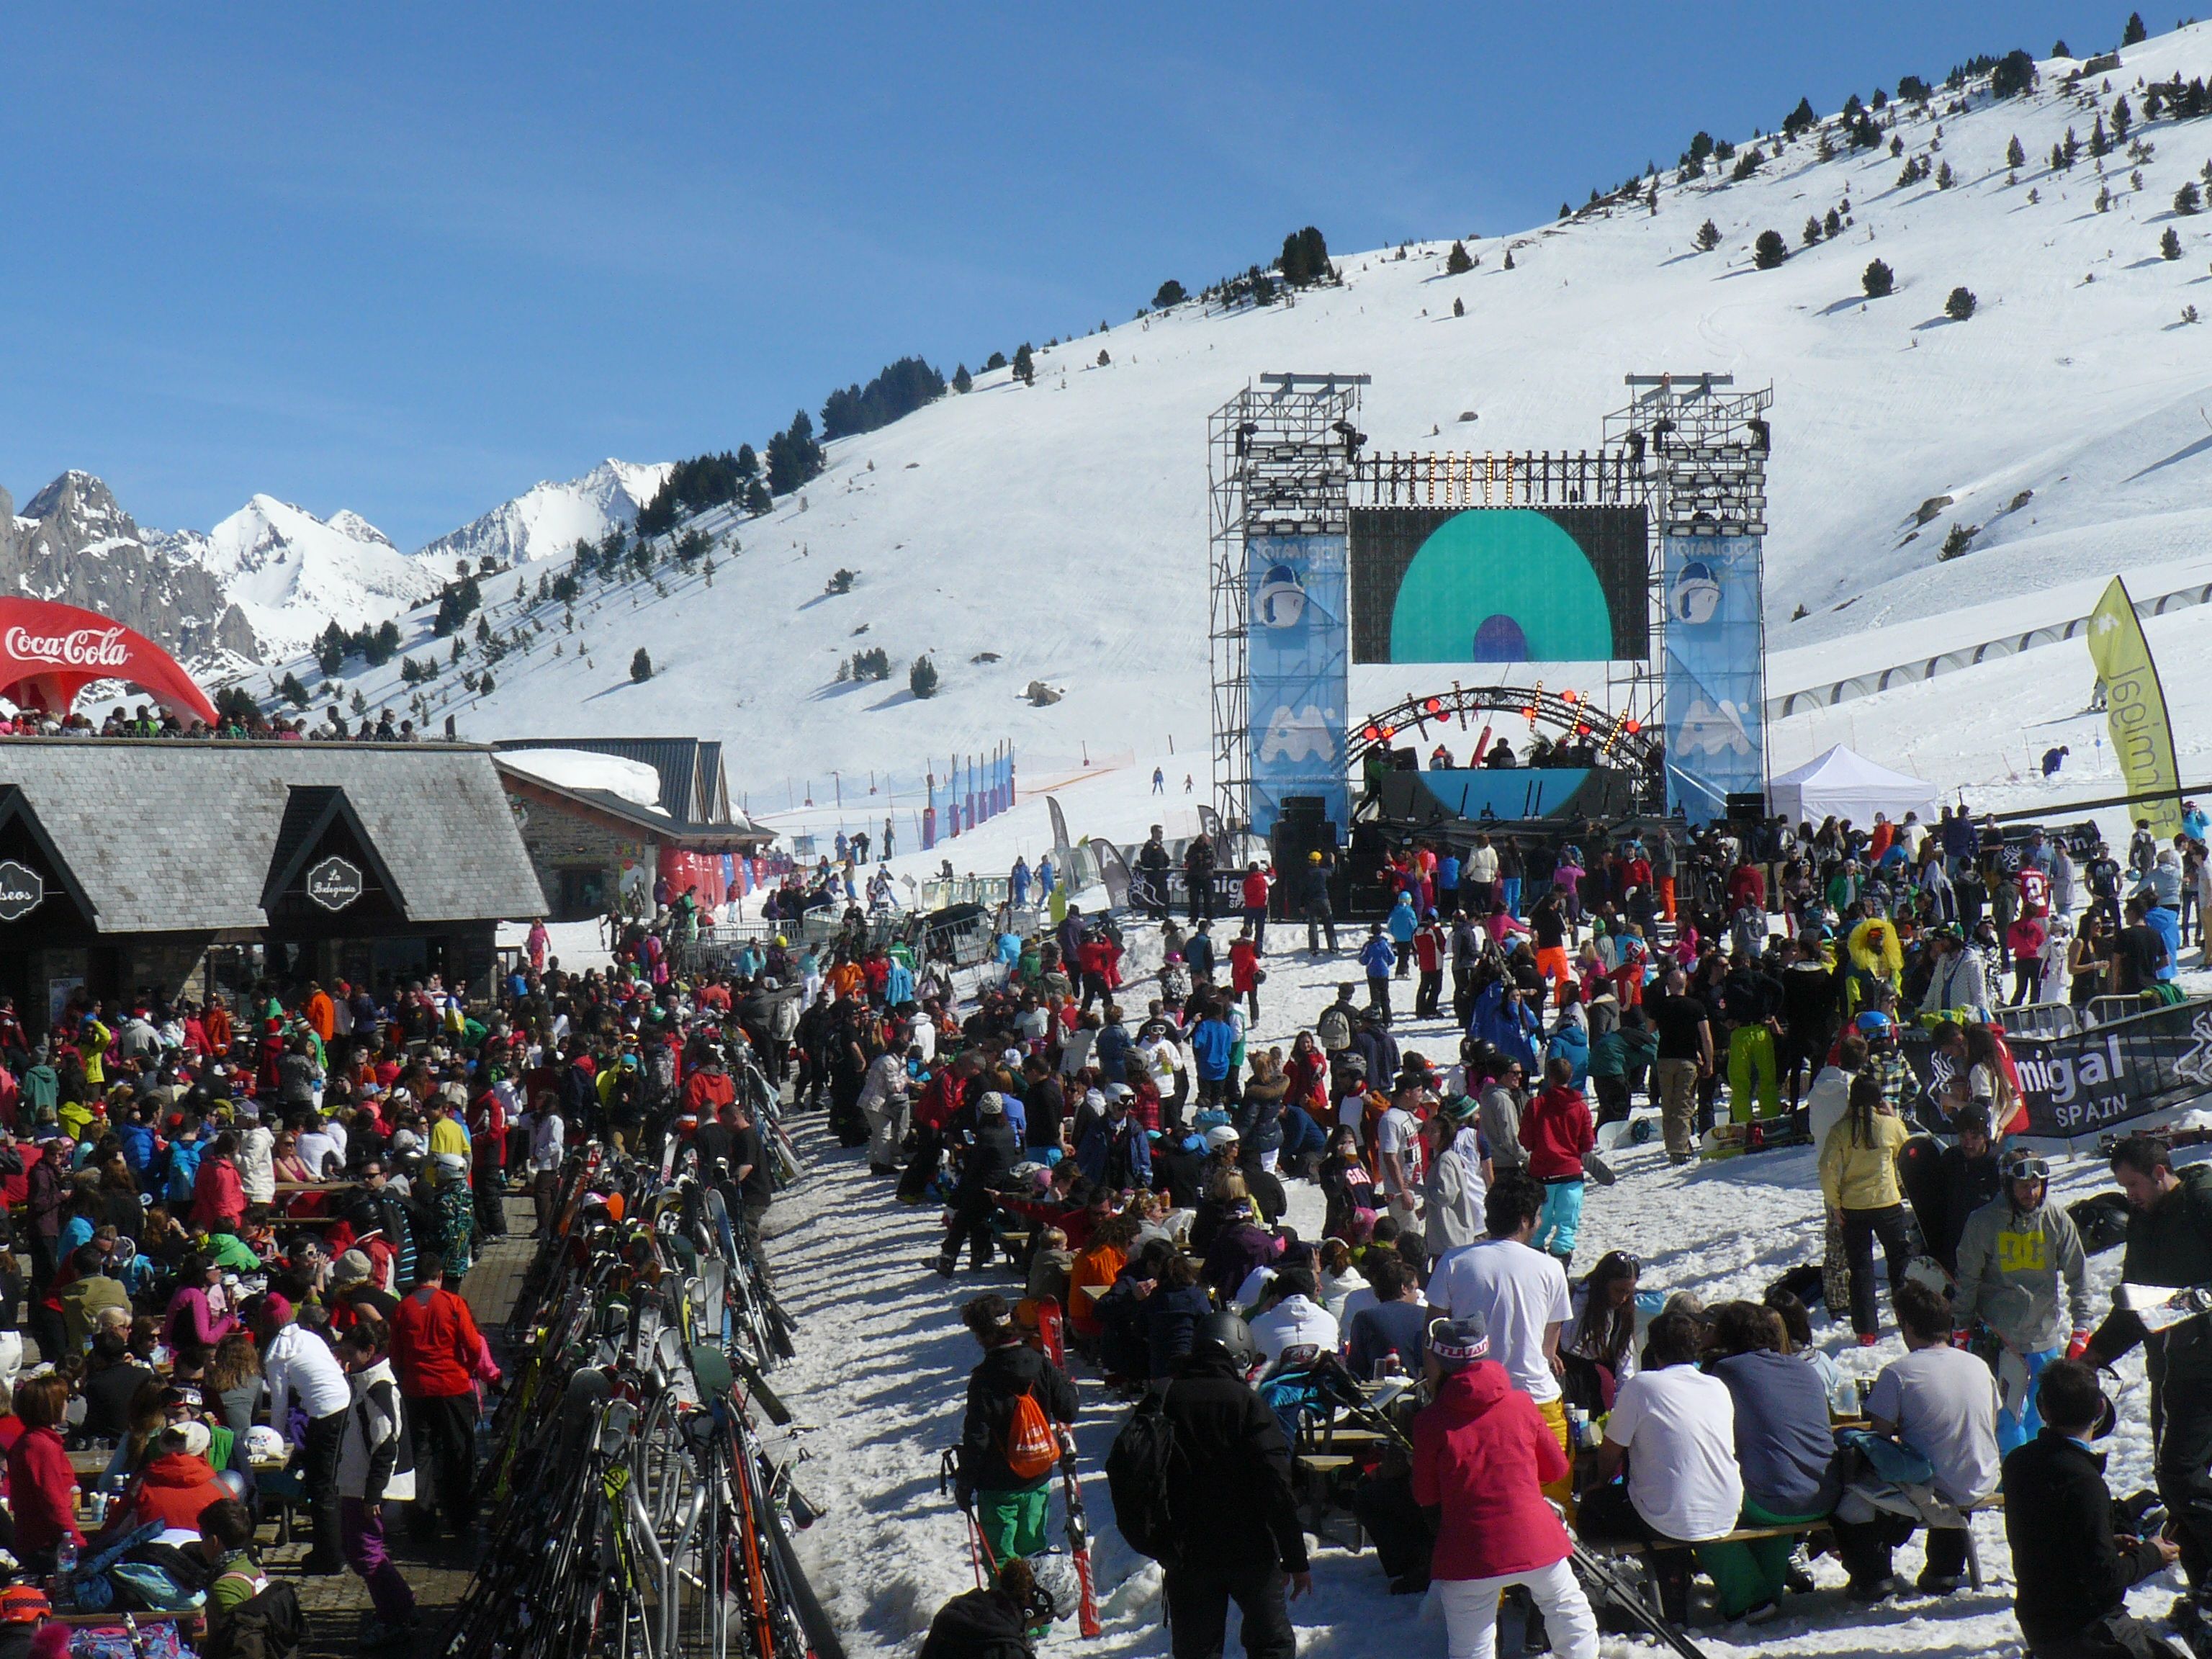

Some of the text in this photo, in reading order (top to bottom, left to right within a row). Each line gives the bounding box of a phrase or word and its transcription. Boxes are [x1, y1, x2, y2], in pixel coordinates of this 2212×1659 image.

[5, 626, 130, 666] Coca-Cola
[0, 881, 34, 901] seos
[2013, 1033, 2125, 1104] migal
[2054, 1093, 2128, 1128] SPAIN
[1998, 1230, 2046, 1273] DC
